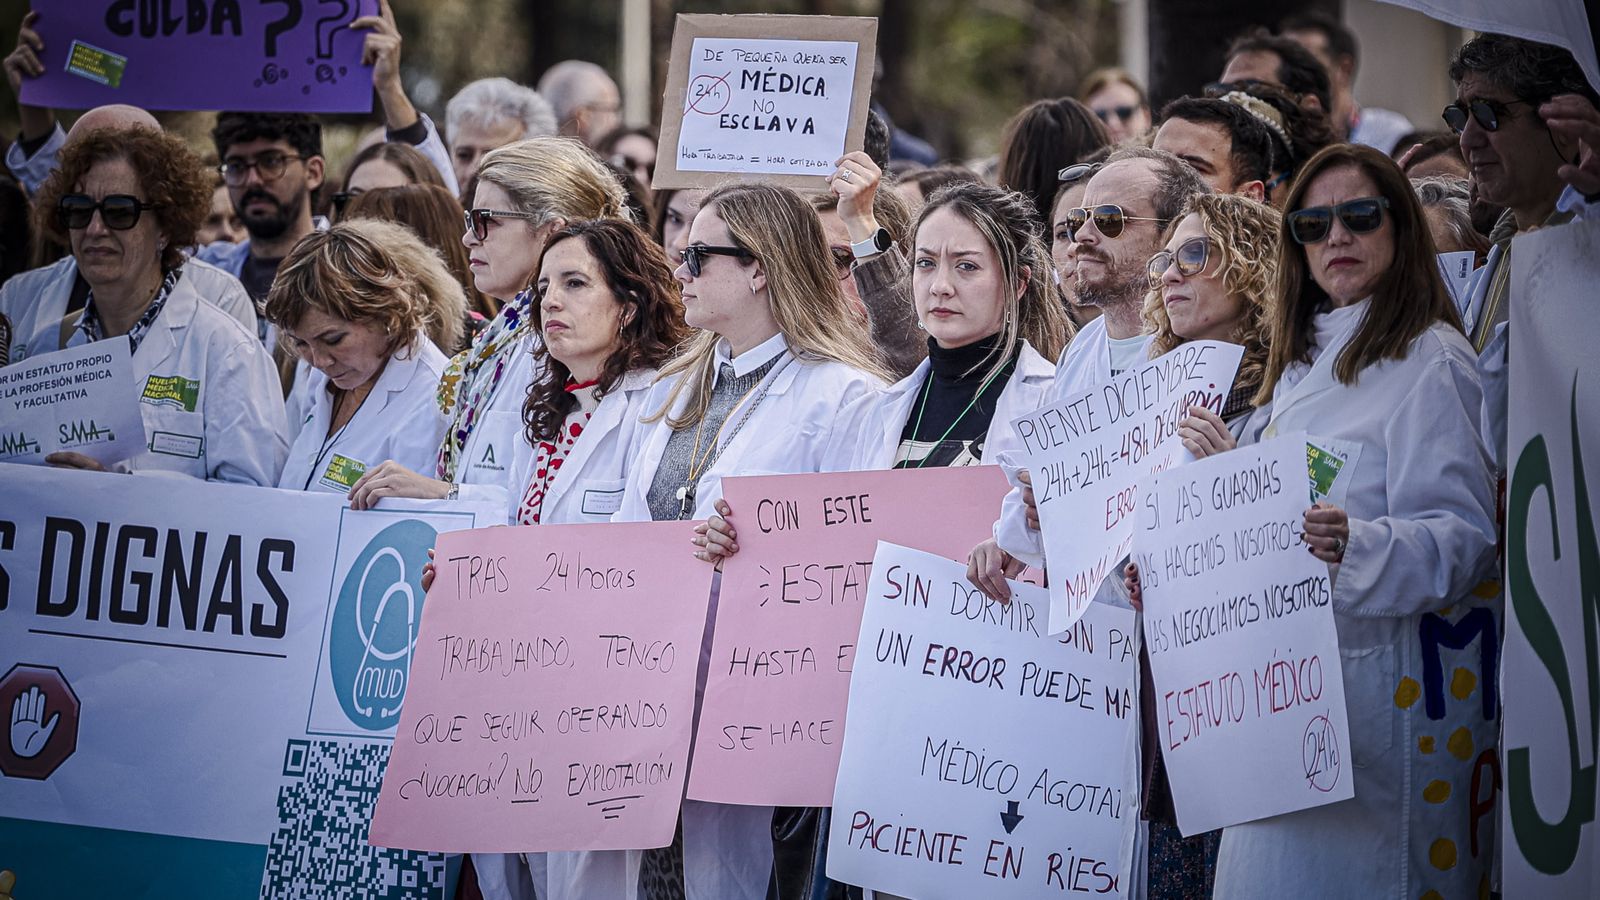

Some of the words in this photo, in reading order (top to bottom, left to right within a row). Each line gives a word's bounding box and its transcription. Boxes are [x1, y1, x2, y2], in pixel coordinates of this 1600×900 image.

[703, 48, 724, 62] DE
[731, 48, 788, 64] PEQUEÑA
[829, 56, 849, 66] SER
[719, 113, 815, 135] ESCLAVA
[753, 99, 775, 114] NO
[766, 156, 786, 165] HORA
[5, 387, 17, 398] LA
[20, 375, 73, 395] PROFESIÓN
[75, 369, 112, 384] MÉDICA
[10, 371, 24, 383] UN
[26, 362, 74, 379] ESTATUTO
[76, 354, 112, 369] PROPIO
[15, 401, 21, 410] Y
[23, 388, 88, 409] FACULTATIVA
[59, 419, 110, 445] SMA
[1017, 393, 1101, 456] PUENTE
[757, 498, 800, 534] CON
[824, 494, 872, 526] ESTE
[1175, 480, 1203, 525] LAS
[35, 516, 295, 639] DIGNAS
[449, 555, 509, 600] TRAS
[1165, 534, 1226, 583] HACEMOS
[883, 565, 931, 608] SIN
[1172, 592, 1260, 648] NEGOCIAMOS
[1264, 576, 1329, 620] NOSOTROS
[599, 634, 675, 673] TENGO
[728, 647, 816, 677] HASTA
[876, 628, 913, 666] UN
[922, 643, 1005, 689] ERROR
[1020, 661, 1094, 711] PUEDE
[360, 666, 403, 700] MUD
[1165, 672, 1245, 751] ESTATUTO
[1254, 648, 1323, 718] MÉDICO
[413, 714, 468, 744] QUE
[480, 711, 545, 743] SEGUIR
[557, 700, 667, 735] OPERANDO
[718, 725, 762, 750] SE
[771, 720, 833, 746] HACE
[566, 752, 673, 796] EXPLOTACIÓN
[921, 736, 1019, 794] MÉDICO
[848, 810, 967, 865] PACIENTE
[983, 840, 1024, 880] EN
[1047, 847, 1119, 893] RIES
